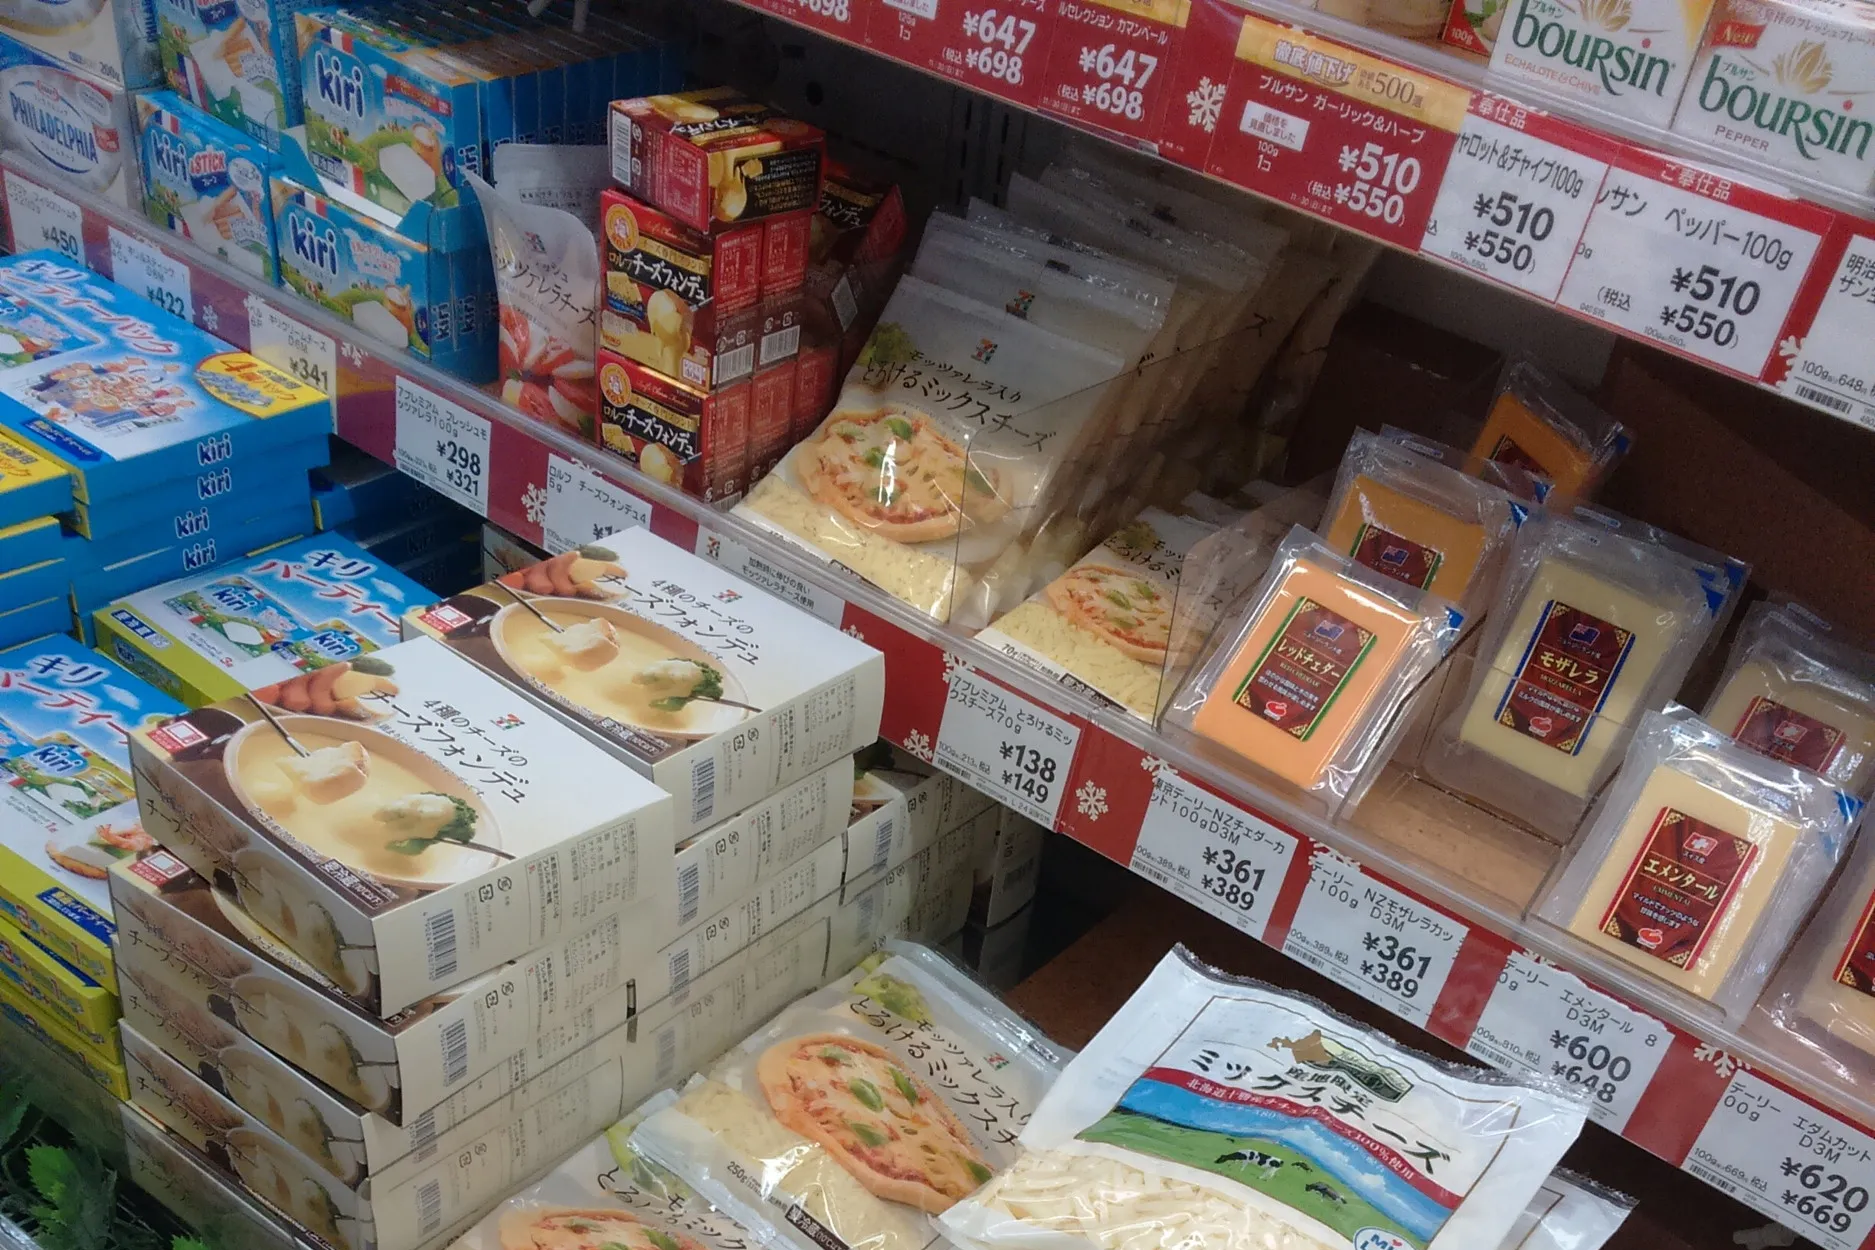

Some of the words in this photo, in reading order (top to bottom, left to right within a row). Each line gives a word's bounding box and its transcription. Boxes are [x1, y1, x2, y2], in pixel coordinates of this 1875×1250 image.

[963, 9, 1036, 55] ¥647
[1117, 18, 1168, 45] カマンベール
[1450, 28, 1474, 46] 100g
[1722, 28, 1756, 46] New
[1079, 43, 1158, 90] ¥647
[1274, 39, 1357, 83] 徹底値下げ
[315, 51, 365, 120] kiri
[9, 90, 99, 164] PHILADELPHIA
[1259, 75, 1309, 103] ブルサン
[1313, 94, 1426, 143] ガーリック&ハーブ
[151, 131, 188, 183] kiri
[1257, 141, 1279, 158] 100g
[1714, 124, 1771, 153] PEPPER
[1255, 155, 1271, 172] 1コ
[1338, 142, 1421, 195] ¥510
[1457, 132, 1584, 199] ャロット&チャイブ100g
[1661, 163, 1732, 201] ご奉仕品
[1473, 191, 1554, 241] ¥510
[290, 212, 338, 277] kiri
[1665, 208, 1793, 272] ペッパー100g
[147, 285, 186, 320] ¥422
[1597, 285, 1631, 312] (税込
[1670, 264, 1761, 316] ¥510
[432, 302, 450, 342] kiri
[289, 357, 328, 391] ¥341
[863, 358, 1057, 452] とろけるミックスチーズ
[197, 433, 233, 466] kiri
[436, 440, 481, 477] ¥298
[197, 467, 232, 500] kiri
[446, 468, 479, 497] ¥321
[579, 480, 647, 524] チーズフォンデュ4
[175, 507, 211, 540] kiri
[182, 539, 217, 571] kiri
[307, 549, 374, 576] キリ
[212, 587, 257, 612] kiri
[596, 573, 760, 666] チーズフォンデュ
[651, 579, 754, 635] 4種のチーズの
[314, 629, 355, 657] kiri
[1277, 639, 1340, 679] レッドチェダー
[30, 655, 105, 684] キリ
[1540, 651, 1599, 685] モザレラ
[949, 689, 1022, 735] クスチーズ70g
[954, 675, 1007, 712] 7プレミアム
[1017, 709, 1072, 746] とろけるミッ
[358, 689, 530, 804] チーズフォンデュ
[422, 699, 529, 767] 4種のチーズの
[34, 747, 76, 775] kiri
[999, 741, 1056, 783] ¥138
[1001, 770, 1049, 803] ¥149
[1202, 846, 1266, 892] ¥361
[1643, 858, 1720, 900] エメンタール
[1201, 874, 1255, 911] ¥389
[1364, 888, 1453, 942] NZモザレラカッ
[1370, 907, 1405, 932] D3M
[1362, 932, 1432, 980] ¥361
[1360, 960, 1419, 999] ¥389
[1559, 988, 1634, 1034] エメンタール
[1645, 1033, 1658, 1048] 8
[1566, 1007, 1605, 1035] D3M
[850, 997, 1019, 1147] とろけるミックスチ
[1550, 1029, 1631, 1082] ¥600
[1285, 1065, 1373, 1106] 産地限定
[1551, 1061, 1617, 1103] ¥648
[1191, 1048, 1450, 1175] ミックスチーズ
[1723, 1095, 1761, 1122] 00g
[1798, 1134, 1842, 1165] D3M
[1730, 1081, 1781, 1114] デーリー
[1793, 1116, 1872, 1163] エダムカット
[1780, 1157, 1870, 1213] ¥620
[1781, 1189, 1852, 1233] ¥669
